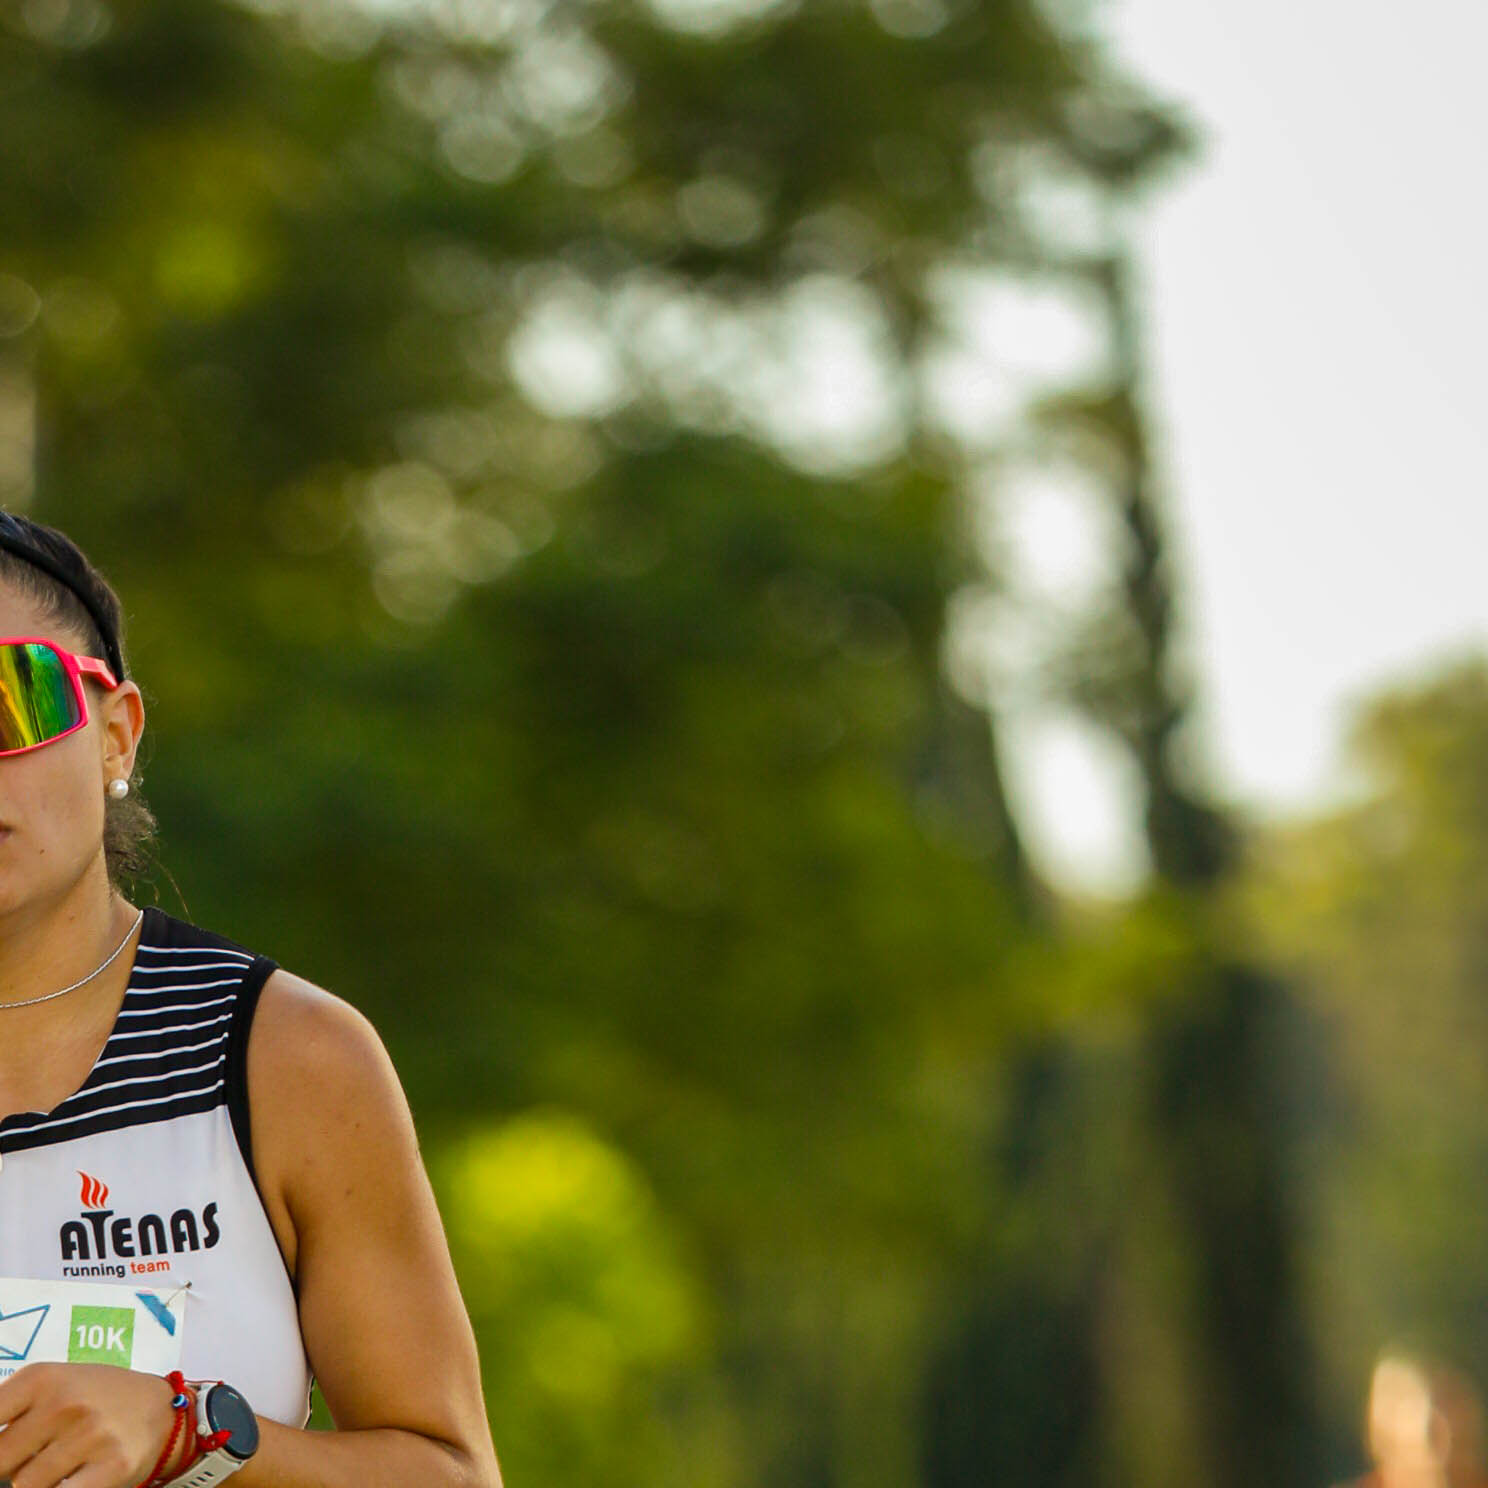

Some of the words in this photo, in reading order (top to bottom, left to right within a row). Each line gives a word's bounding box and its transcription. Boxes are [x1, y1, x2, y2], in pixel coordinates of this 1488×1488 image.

[60, 1202, 221, 1261] ATENAS
[63, 1262, 126, 1279] running
[130, 1260, 172, 1276] team
[76, 1324, 127, 1353] 10K
